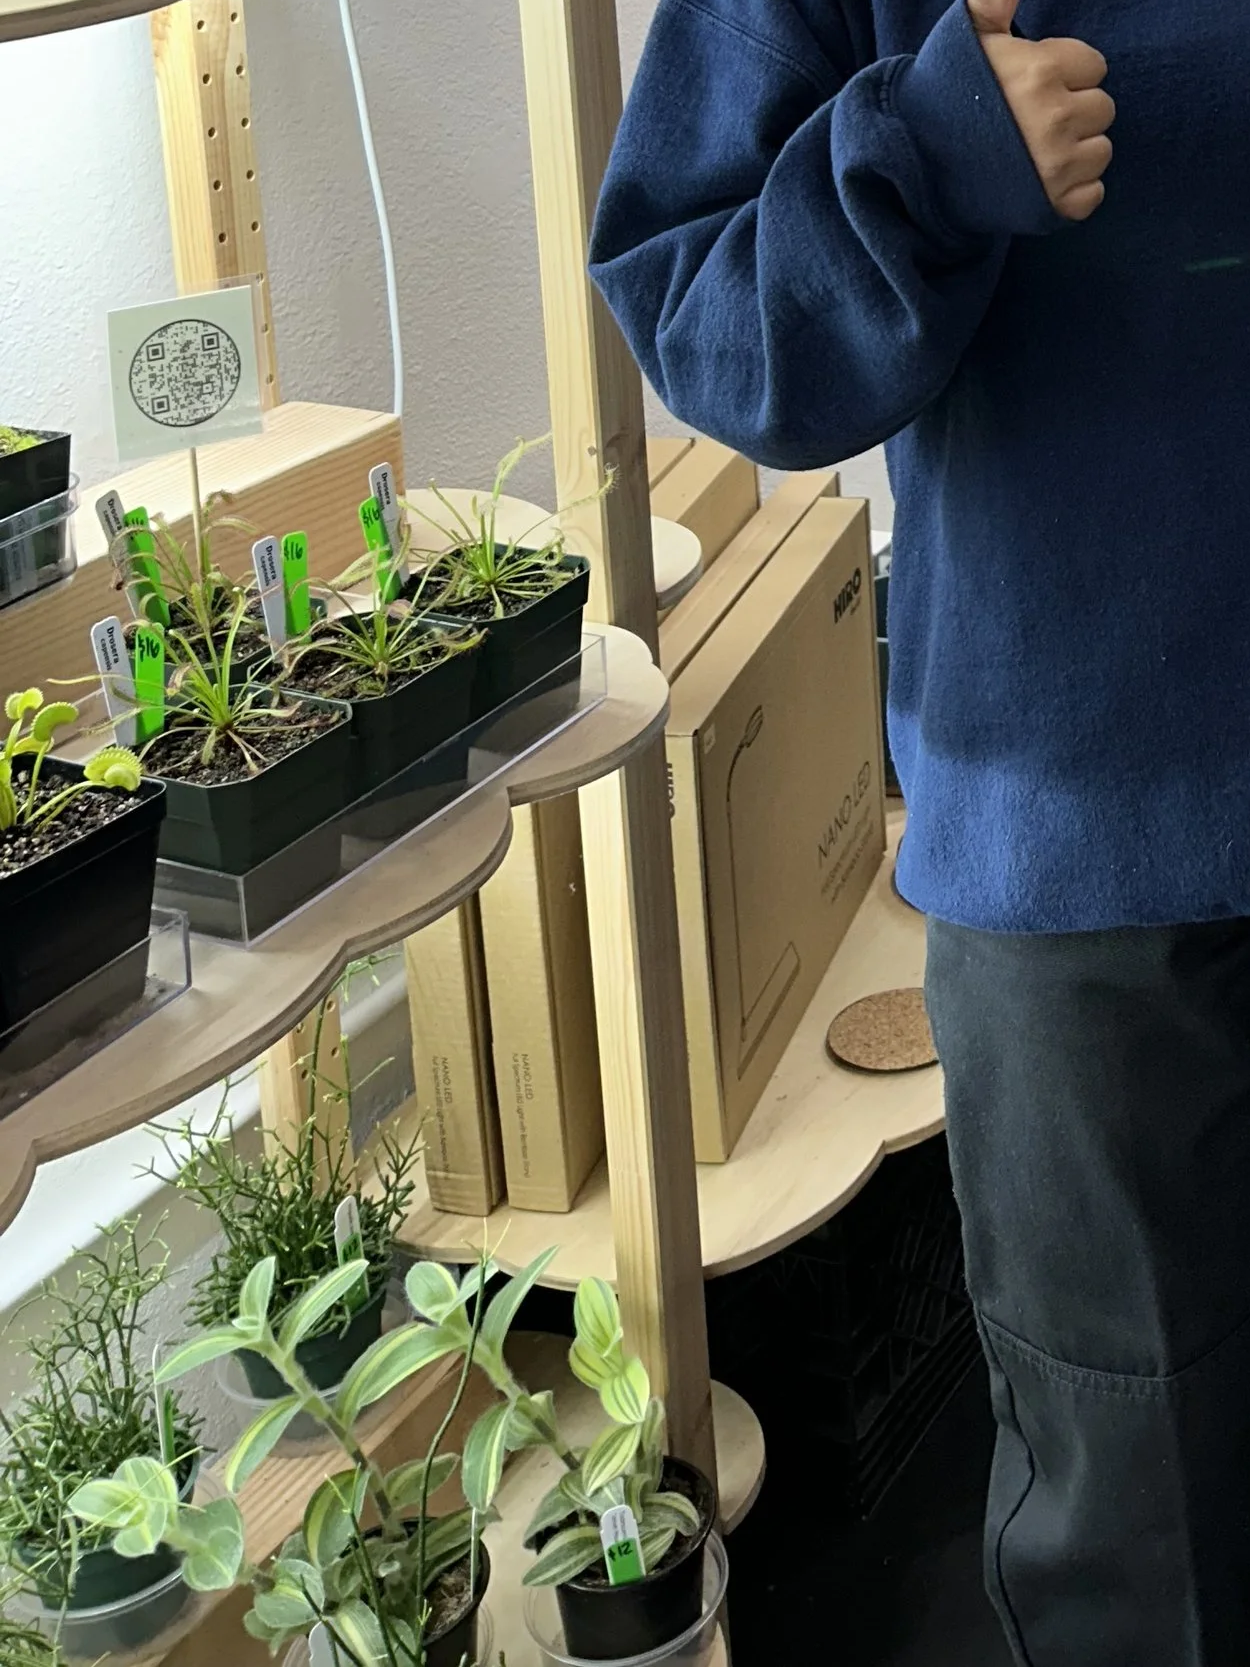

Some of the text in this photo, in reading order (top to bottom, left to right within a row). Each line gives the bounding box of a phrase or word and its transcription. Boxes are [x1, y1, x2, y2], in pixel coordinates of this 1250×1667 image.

[381, 472, 391, 505] Drosera
[107, 498, 122, 531] Drosera
[361, 507, 380, 528] $16
[265, 545, 277, 580] Drosera
[284, 539, 303, 562] $16
[833, 567, 862, 624] HIRO
[106, 626, 120, 664] Drosera
[138, 633, 160, 662] $16
[818, 794, 852, 869] NANO
[853, 761, 871, 807] LED
[441, 1056, 453, 1104] NANO LED
[521, 1053, 534, 1100] NANO LED
[607, 1541, 633, 1562] $12
